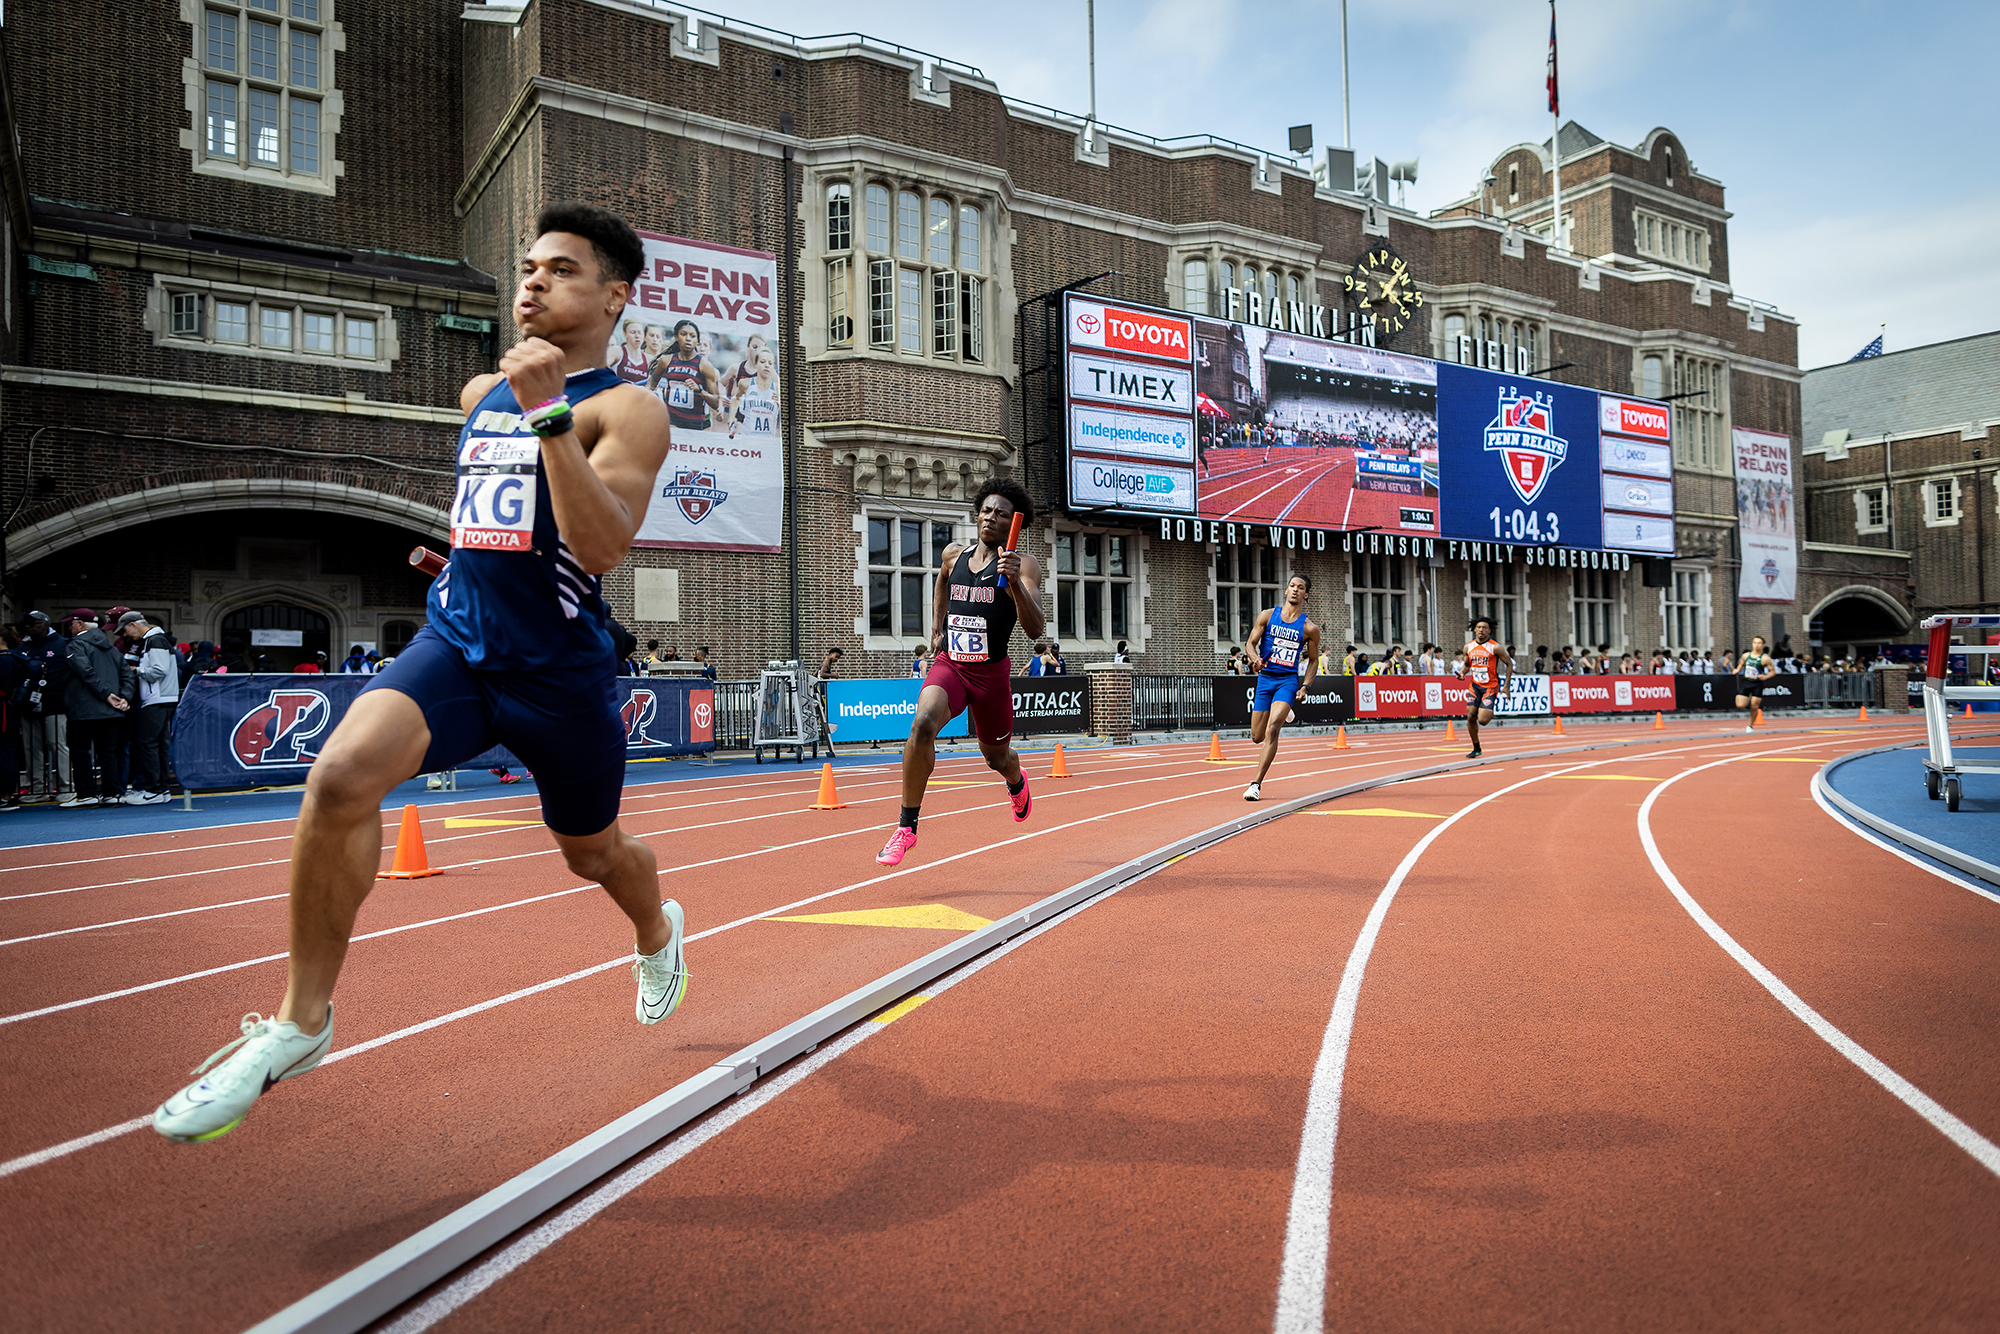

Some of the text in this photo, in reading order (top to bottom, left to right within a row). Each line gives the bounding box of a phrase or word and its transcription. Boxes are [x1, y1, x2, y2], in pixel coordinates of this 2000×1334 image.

[654, 258, 770, 299] PENN
[1344, 275, 1354, 292] 9
[1415, 291, 1423, 307] 5
[1229, 287, 1375, 347] FRANKLIN
[1108, 318, 1186, 349] TOYOTA
[1459, 335, 1528, 376] FIELD
[667, 365, 698, 377] PENN
[1088, 367, 1176, 403] TIMEX
[673, 387, 689, 404] AJ
[755, 417, 770, 431] AA
[1622, 409, 1666, 430] TOYOTA
[1082, 421, 1170, 444] Independence
[1487, 432, 1564, 455] PENN RELAYS
[1751, 443, 1787, 461] PENN
[1369, 461, 1410, 474] PENN RELAYS
[1738, 457, 1788, 475] RELAYS
[1093, 466, 1168, 494] College AVE
[457, 478, 524, 525] KG
[665, 488, 726, 499] PENN RELAYS
[1489, 506, 1560, 543] 1:04.3
[465, 530, 520, 546] TOYOTA
[1161, 517, 1630, 572] ROBERT WOOD JOHNSON FAMILY SCOREBOARD
[950, 584, 994, 603] PENN WOOD
[1270, 624, 1299, 641] KNIGHTS
[951, 632, 983, 652] KB
[1273, 647, 1294, 661] KH
[1012, 690, 1083, 711] OTRACK
[1328, 691, 1343, 704] On.
[1379, 690, 1418, 703] TOYOTA
[1444, 689, 1469, 702] TOYO
[1571, 687, 1609, 700] TOYOTA
[1633, 687, 1672, 699] TOYOTA
[840, 700, 918, 719] Independe
[1030, 709, 1053, 718] STREAM
[1054, 708, 1081, 716] PARTNER
